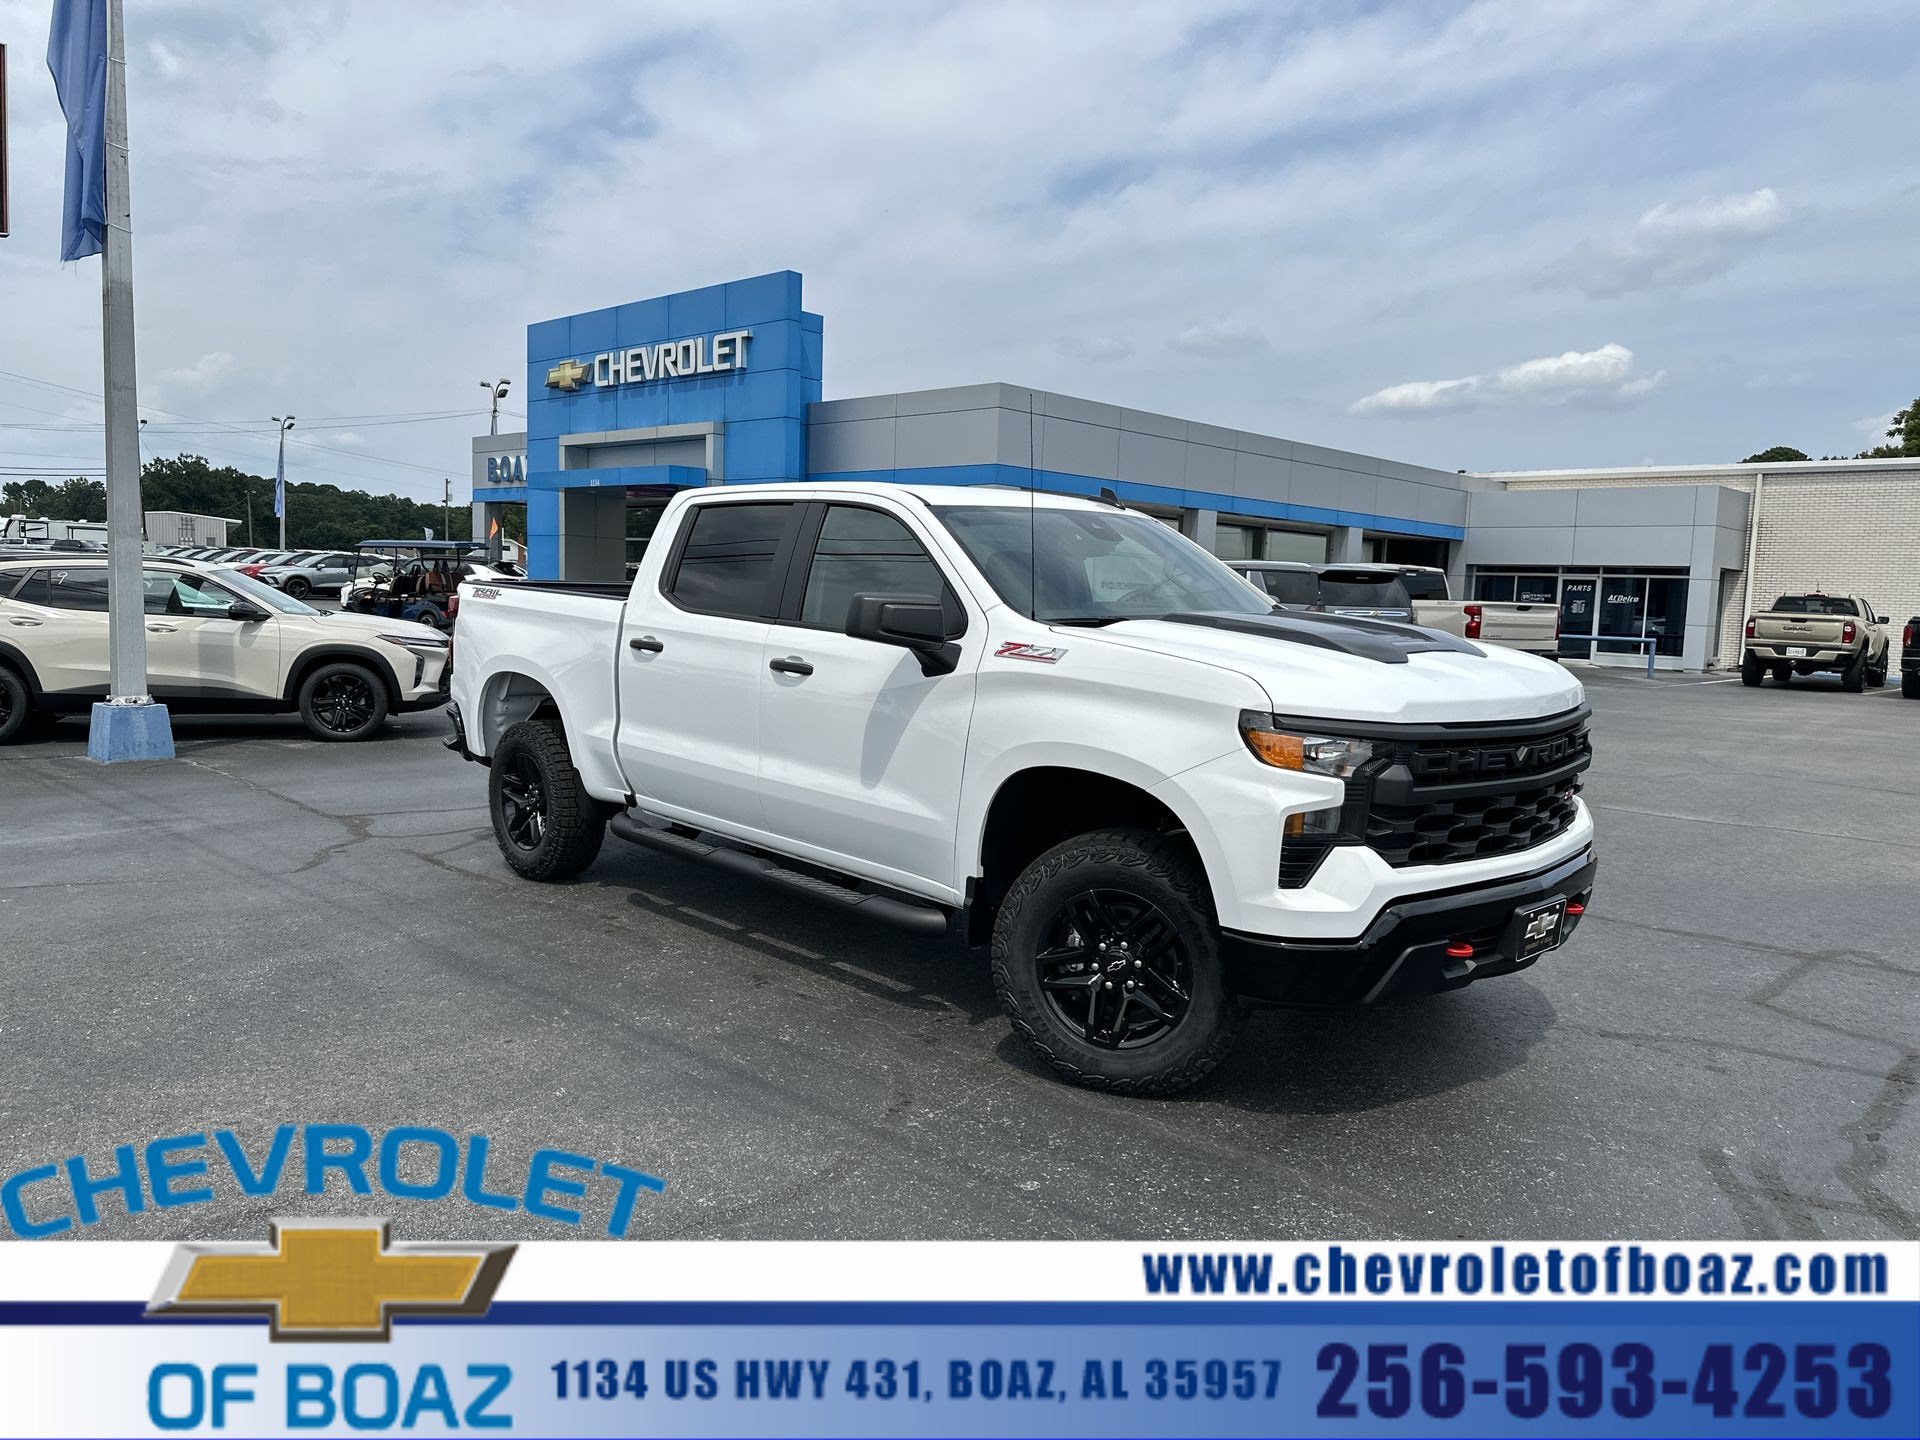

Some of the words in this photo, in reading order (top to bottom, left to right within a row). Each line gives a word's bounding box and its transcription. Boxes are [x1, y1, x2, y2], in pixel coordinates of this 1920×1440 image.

[594, 330, 753, 387] CHEVROLET
[488, 455, 527, 483] BOA
[58, 571, 68, 584] 9
[472, 587, 502, 596] TRAIL
[472, 592, 497, 600] BOSS
[1607, 595, 1640, 603] ACDelco
[994, 641, 1068, 664] Z71
[1412, 726, 1591, 776] CHEVROLE
